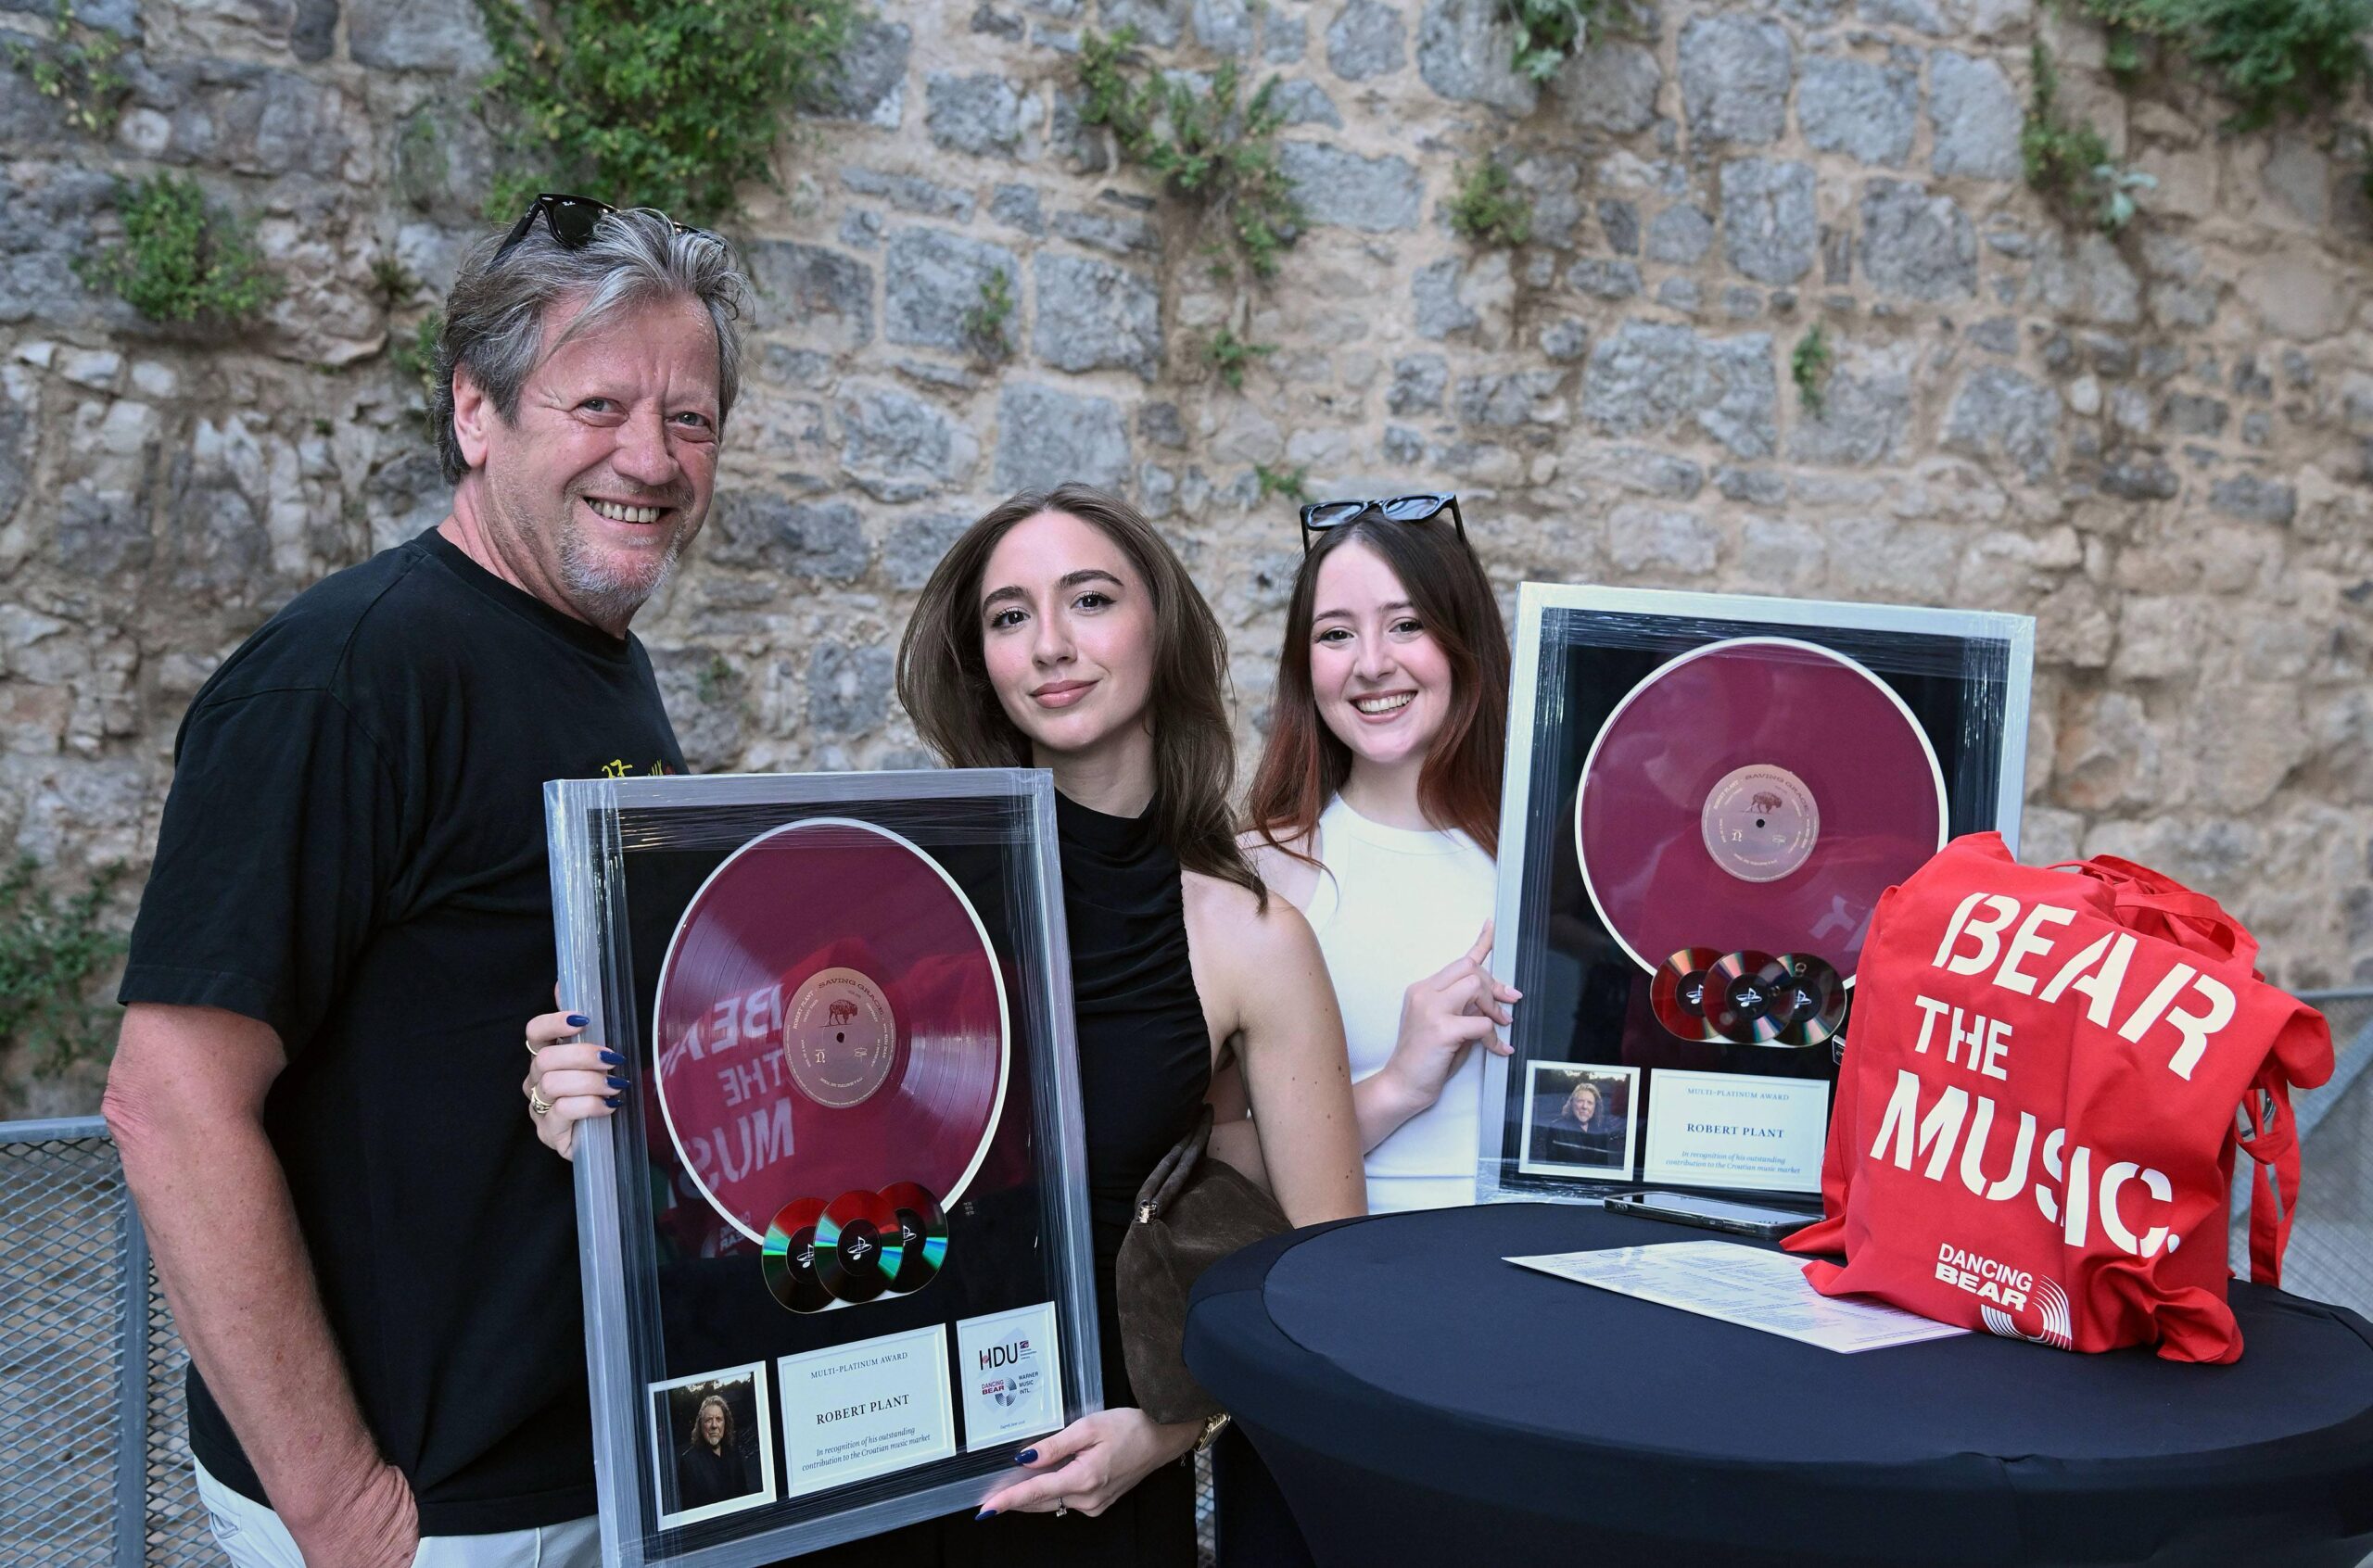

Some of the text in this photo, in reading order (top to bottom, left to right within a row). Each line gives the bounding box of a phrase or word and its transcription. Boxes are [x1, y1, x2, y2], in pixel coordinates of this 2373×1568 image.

[1785, 781, 1809, 812] GRACE
[1933, 891, 2237, 1080] BEAR
[793, 1008, 804, 1030] ROBERT
[800, 991, 815, 1007] PLANT
[818, 978, 857, 989] SAVING
[857, 983, 884, 1016] GRACE
[1915, 995, 2013, 1081] THE
[1687, 1087, 1790, 1101] MULTI-PLATINUM AWARD
[1687, 1122, 1785, 1139] ROBERT PLANT
[1666, 1158, 1707, 1168] contribution
[1715, 1161, 1725, 1170] the
[1727, 1161, 1756, 1171] Croatian
[1757, 1164, 1776, 1172] music
[1777, 1165, 1800, 1174] market
[1689, 1152, 1728, 1161] recognition
[1727, 1153, 1736, 1162] of
[1735, 1153, 1745, 1161] his
[1745, 1155, 1785, 1165] outstanding
[1870, 1069, 2181, 1258] MUSIC.
[1937, 1243, 2034, 1294] DANCING
[1935, 1261, 2030, 1312] BEAR
[810, 1351, 908, 1380] MULTI-PLATINUM AWARD
[979, 1343, 1019, 1371] HDU
[981, 1379, 1004, 1390] DANCING
[982, 1385, 1005, 1396] BEAR
[1019, 1372, 1039, 1381] WARNER
[1019, 1379, 1034, 1388] MUSIC
[816, 1394, 910, 1425] ROBERT PLANT
[802, 1455, 843, 1472] contribution
[850, 1450, 861, 1460] the
[861, 1444, 889, 1458] Croatian
[890, 1439, 908, 1450] music
[908, 1434, 931, 1446] market
[816, 1448, 824, 1457] In
[824, 1440, 861, 1455] recognition
[860, 1436, 869, 1448] of
[878, 1426, 916, 1442] outstanding
